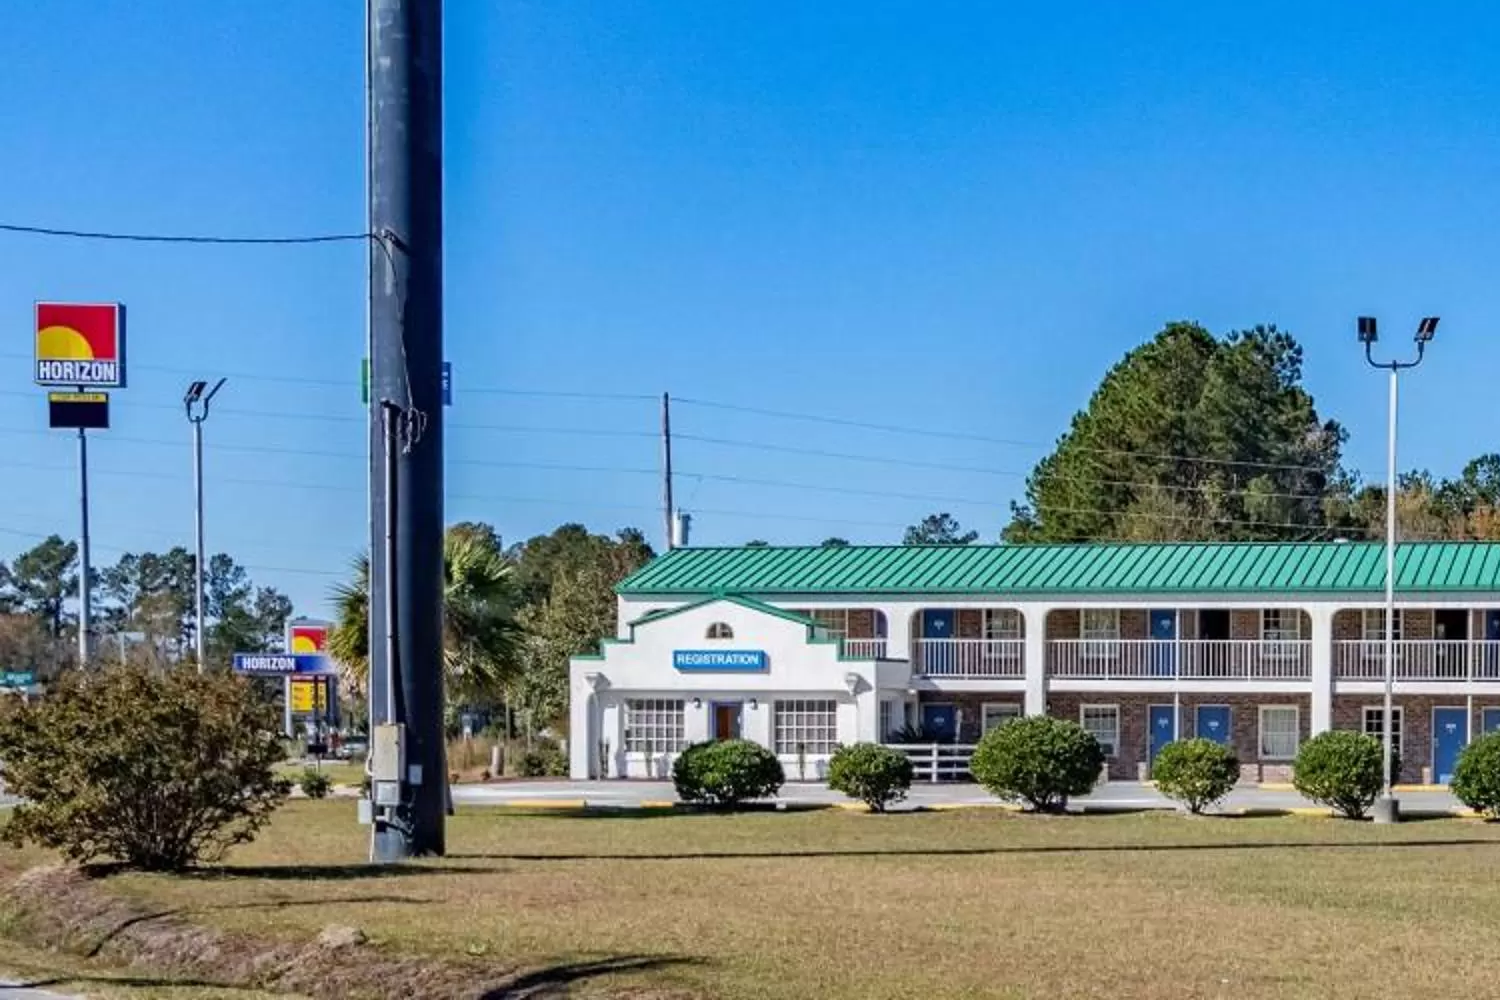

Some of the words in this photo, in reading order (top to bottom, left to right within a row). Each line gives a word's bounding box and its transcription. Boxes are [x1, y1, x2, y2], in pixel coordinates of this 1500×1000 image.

[39, 361, 116, 381] HORIZON
[242, 657, 296, 670] HORIZON
[676, 653, 760, 665] REGISTRATION
